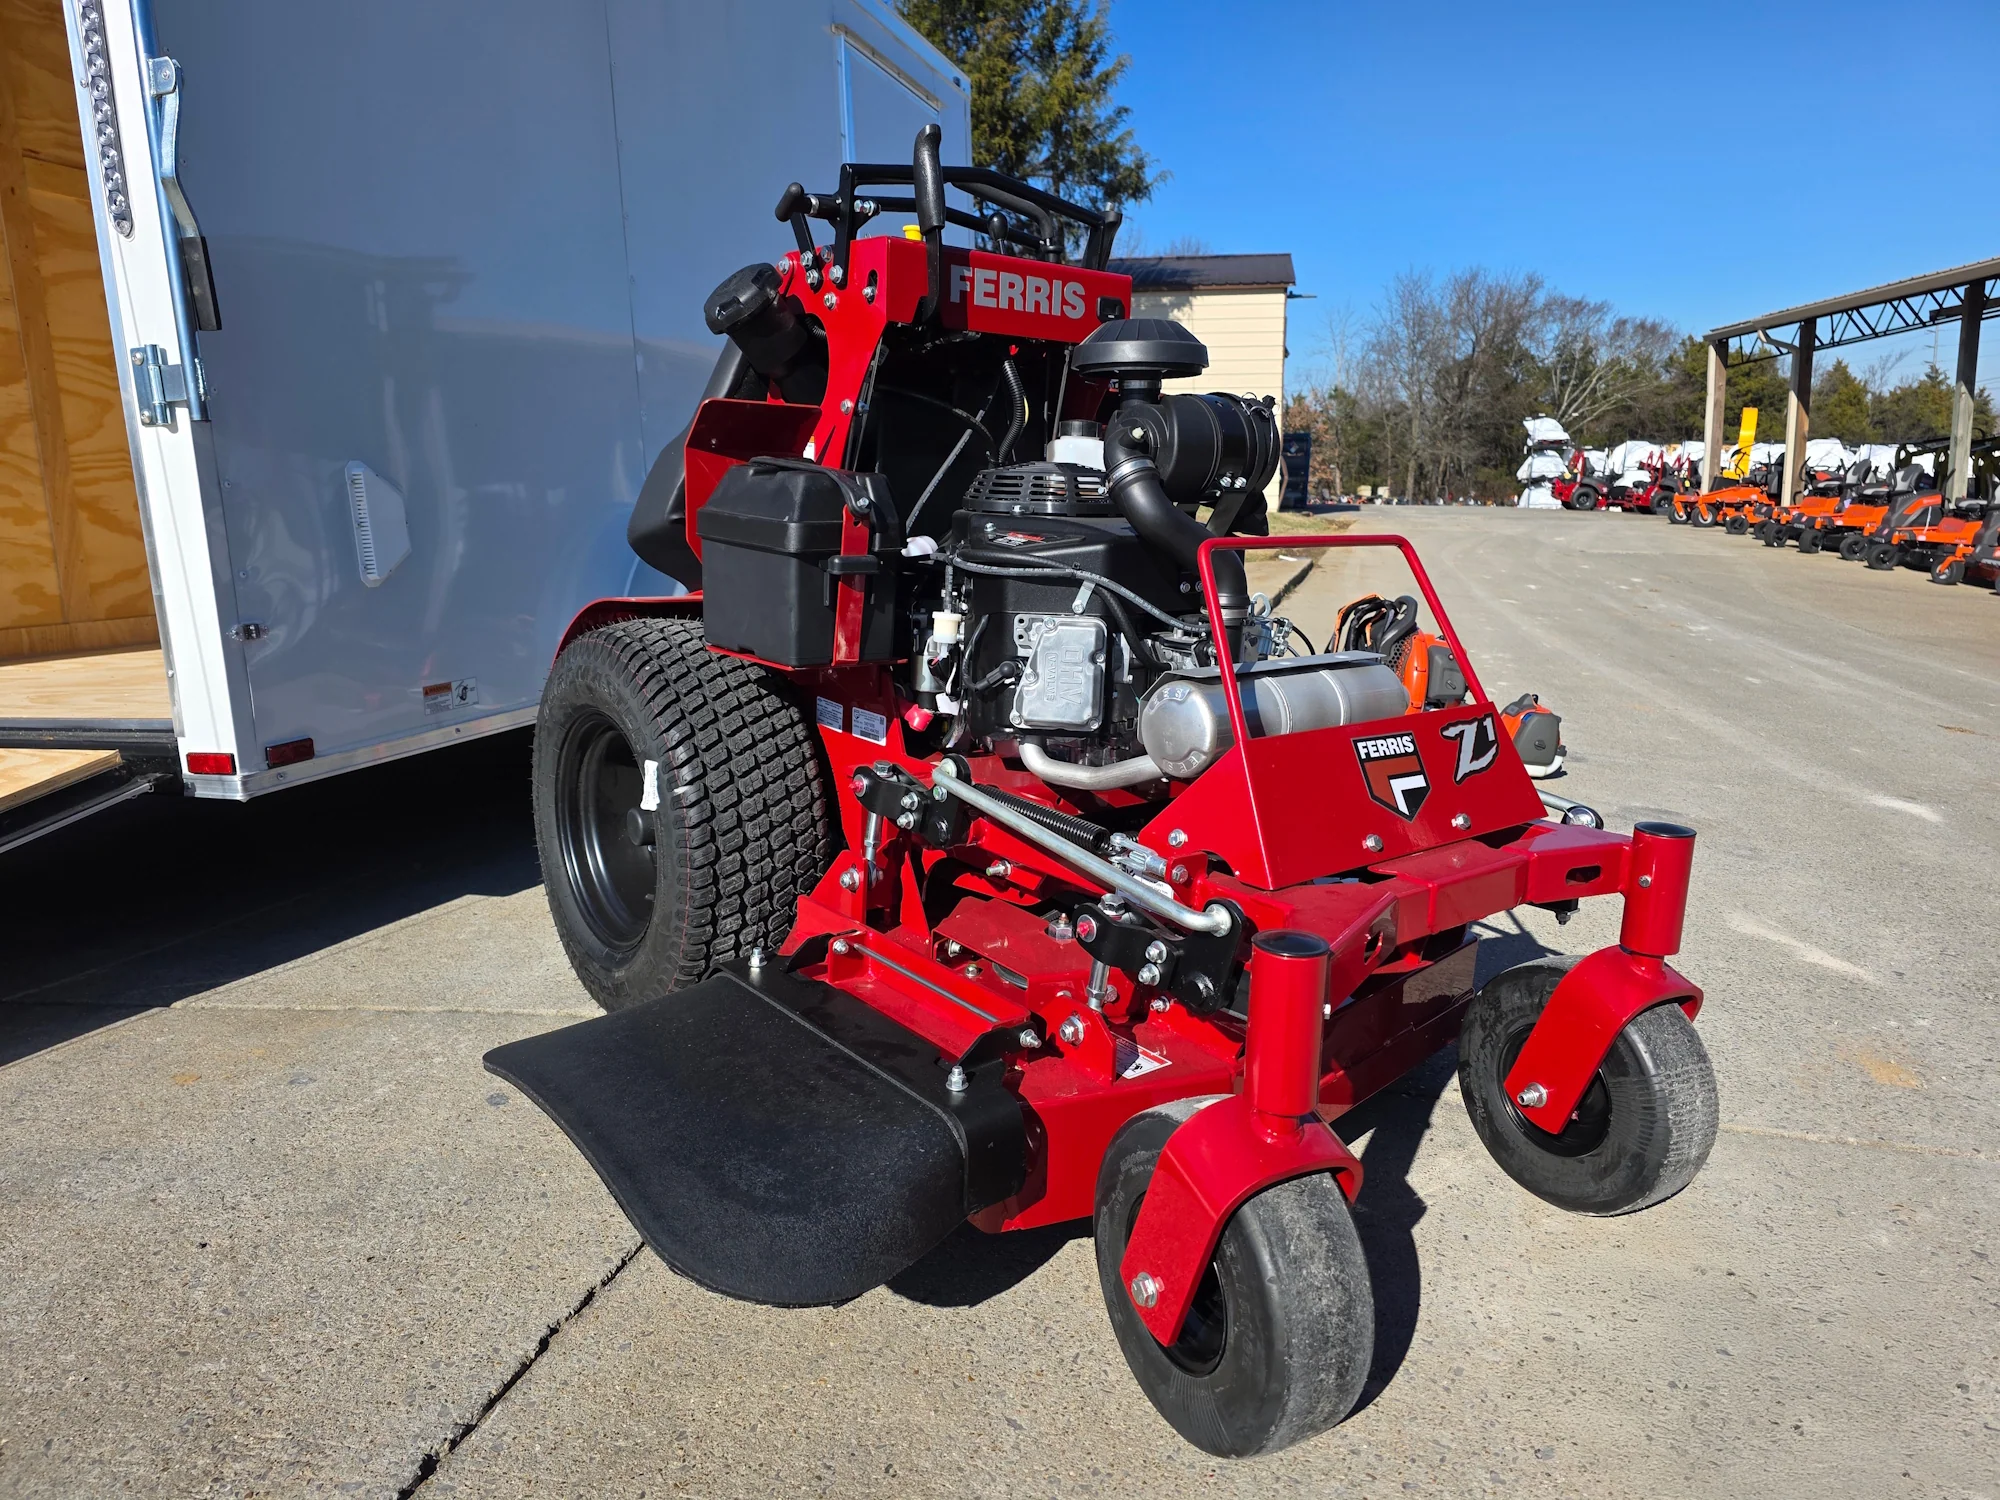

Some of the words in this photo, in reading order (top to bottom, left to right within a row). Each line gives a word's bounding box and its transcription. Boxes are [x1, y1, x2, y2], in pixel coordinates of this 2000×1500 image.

[950, 263, 1086, 319] FERRIS
[1060, 645, 1085, 705] OHV
[1356, 735, 1415, 760] FERRIS
[1442, 716, 1498, 782] Z1
